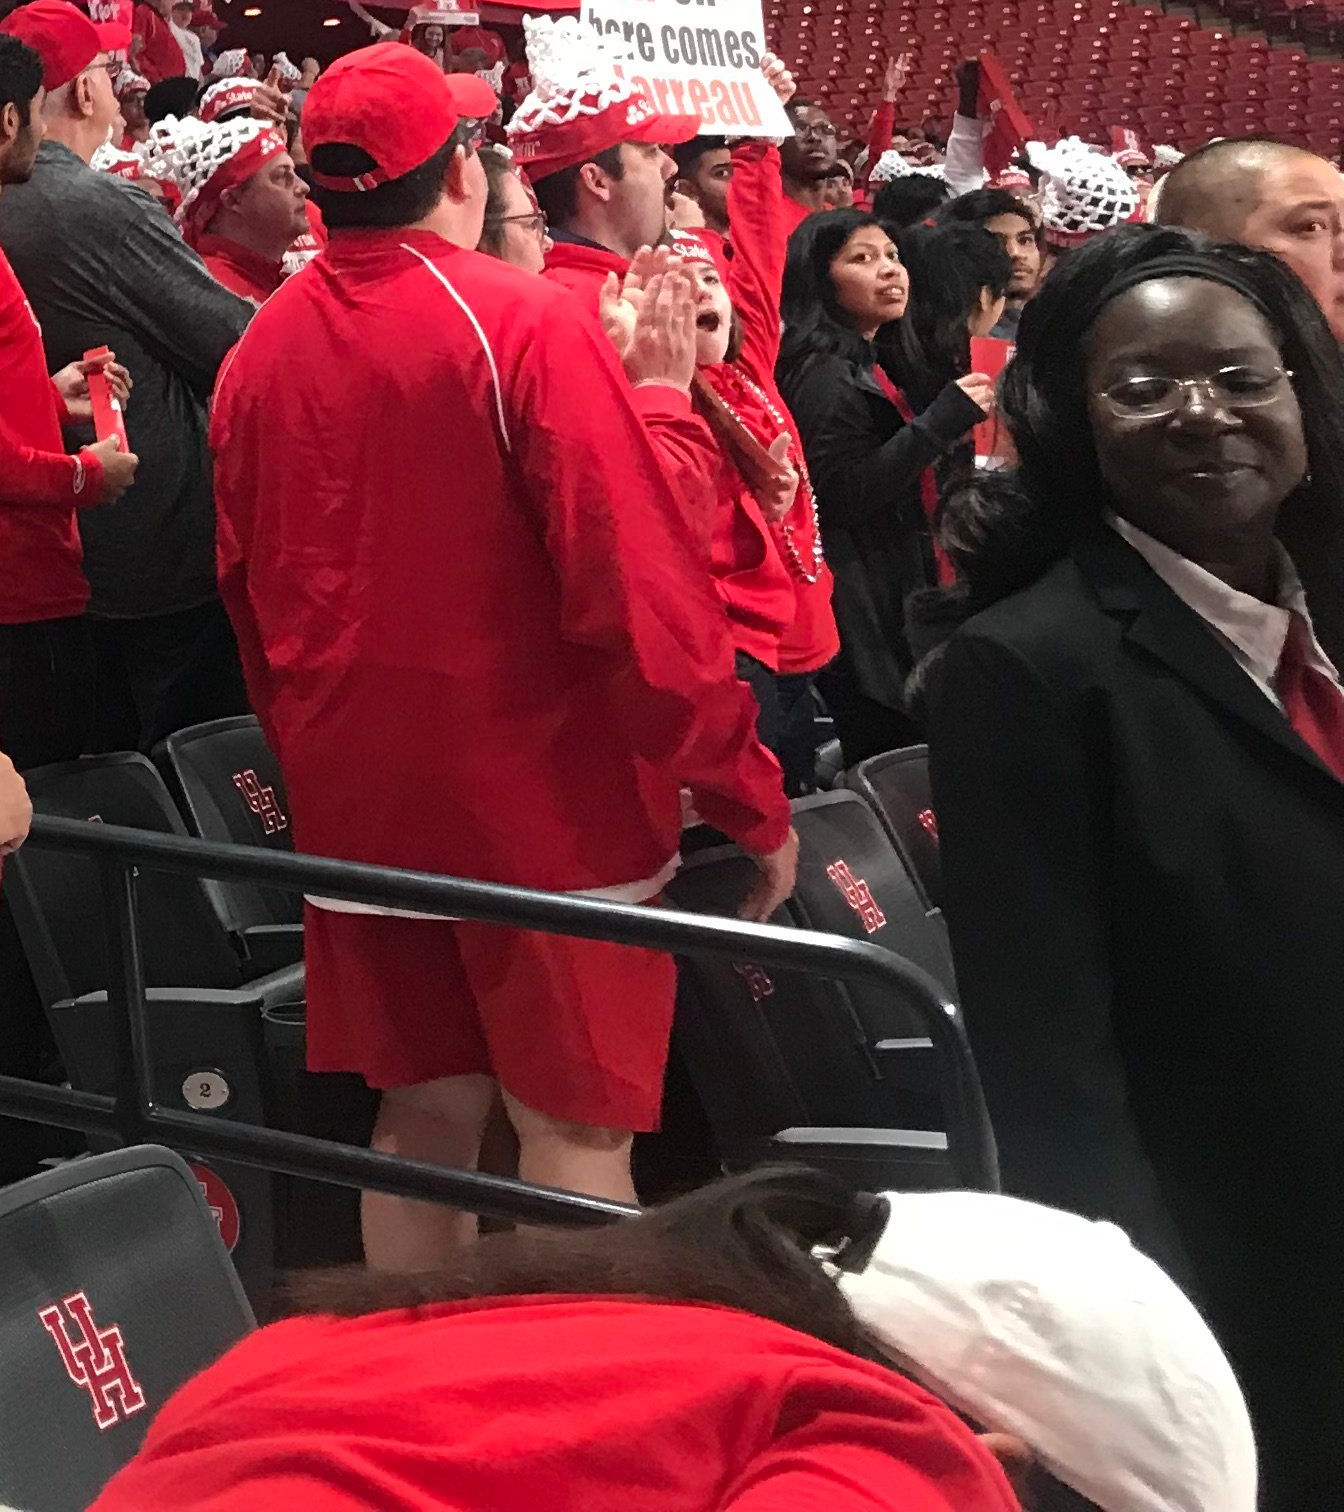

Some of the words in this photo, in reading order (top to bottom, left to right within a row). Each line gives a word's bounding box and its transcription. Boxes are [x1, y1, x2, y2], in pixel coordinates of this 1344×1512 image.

[588, 7, 656, 63] hre
[661, 23, 760, 70] comes
[612, 64, 762, 127] arreau
[231, 768, 288, 835] UH
[198, 1082, 212, 1097] 2
[37, 1289, 148, 1432] UH
